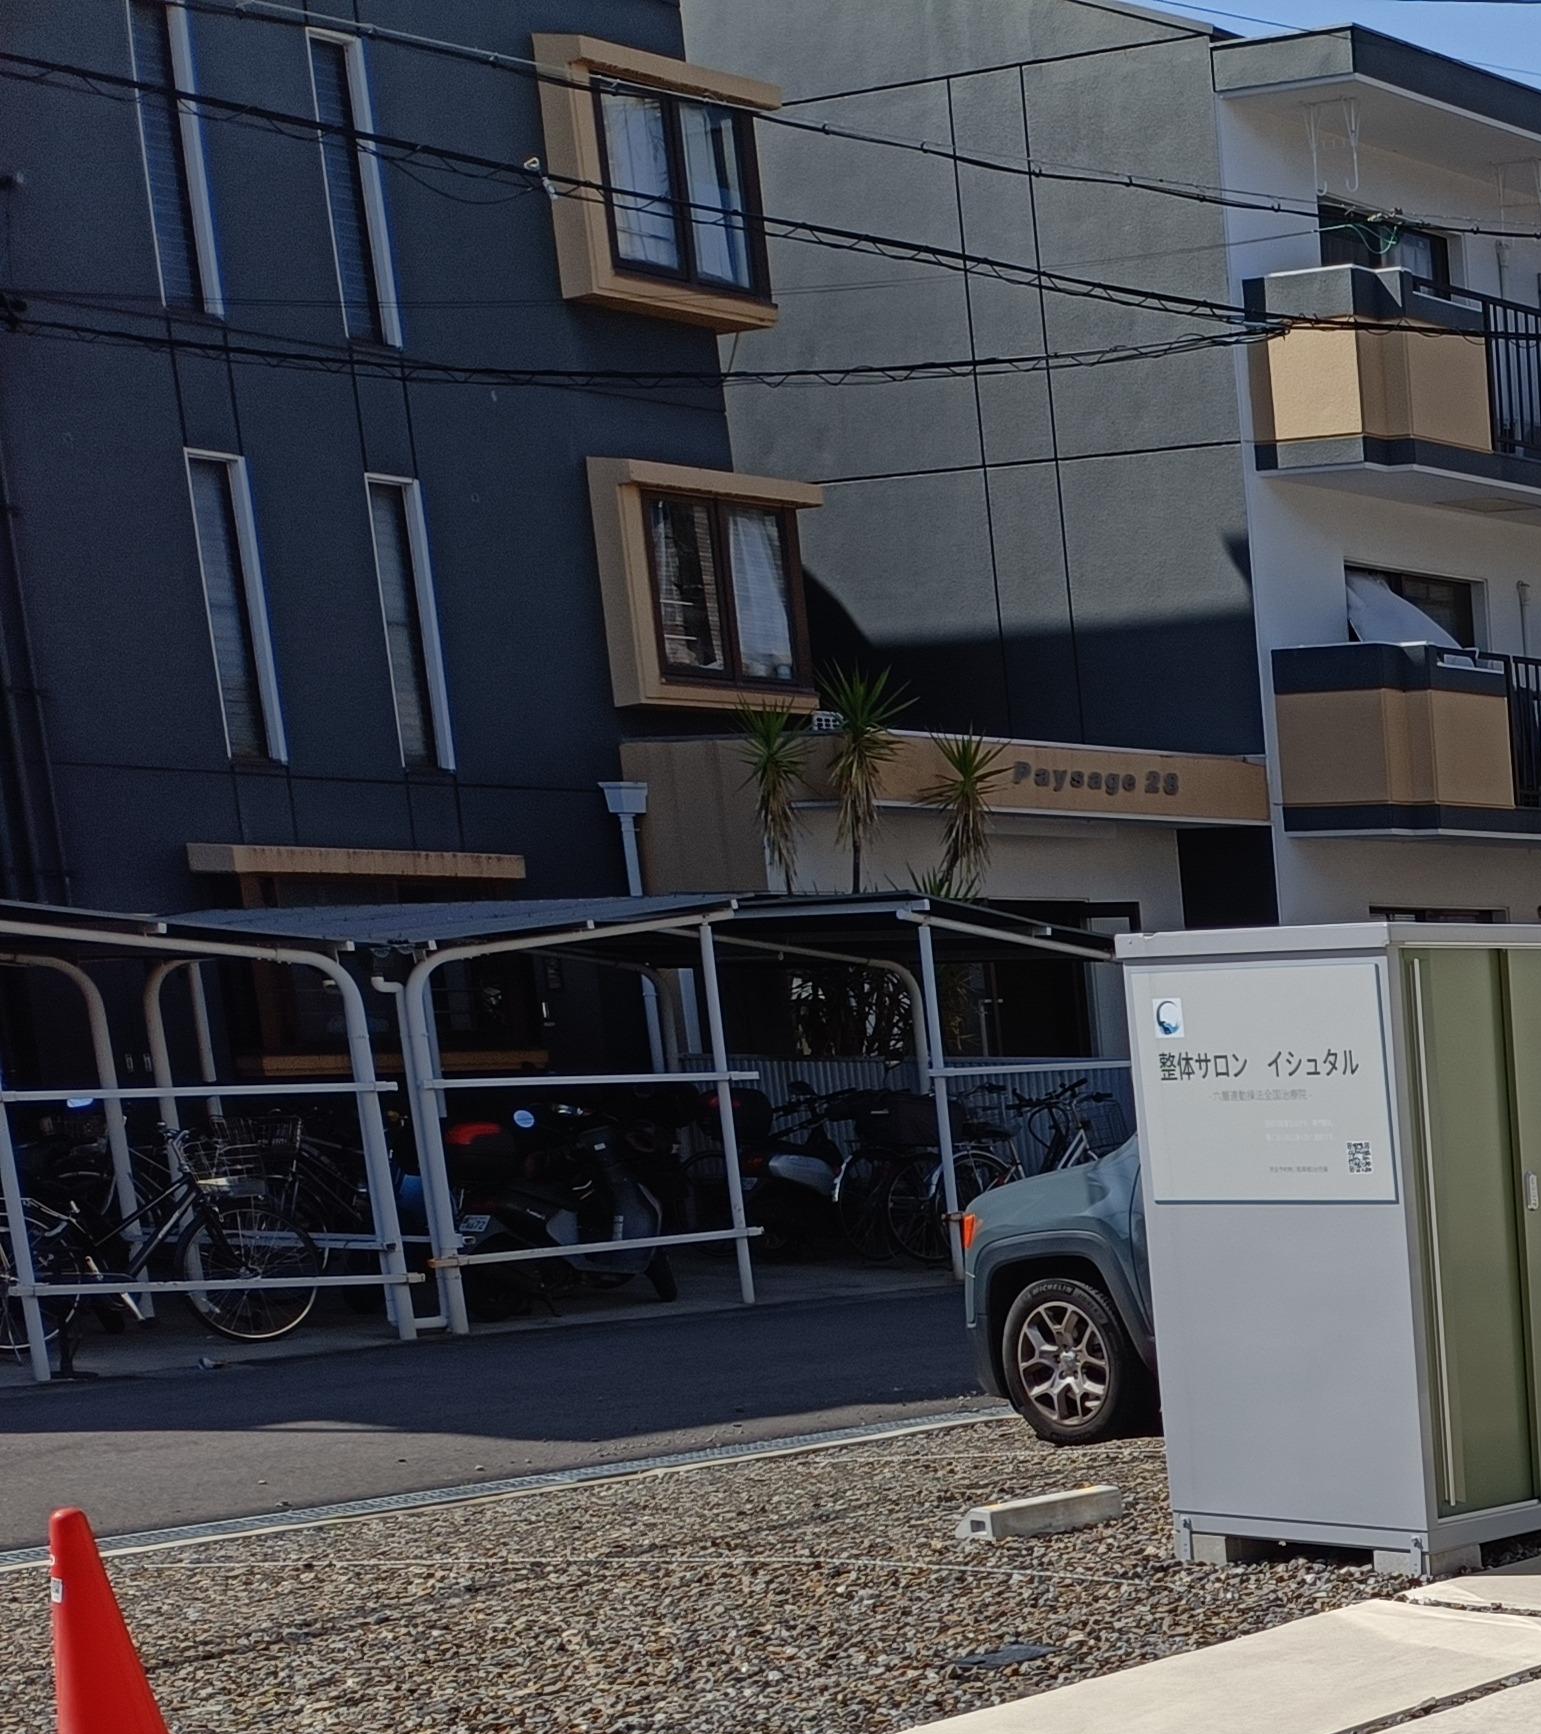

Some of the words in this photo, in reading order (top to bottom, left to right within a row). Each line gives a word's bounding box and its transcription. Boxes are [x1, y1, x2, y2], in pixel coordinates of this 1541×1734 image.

[1013, 761, 1137, 796] Paysage
[1144, 769, 1180, 796] 28
[1158, 1051, 1248, 1082] 整体サロン
[1267, 1048, 1360, 1078] イシュタル
